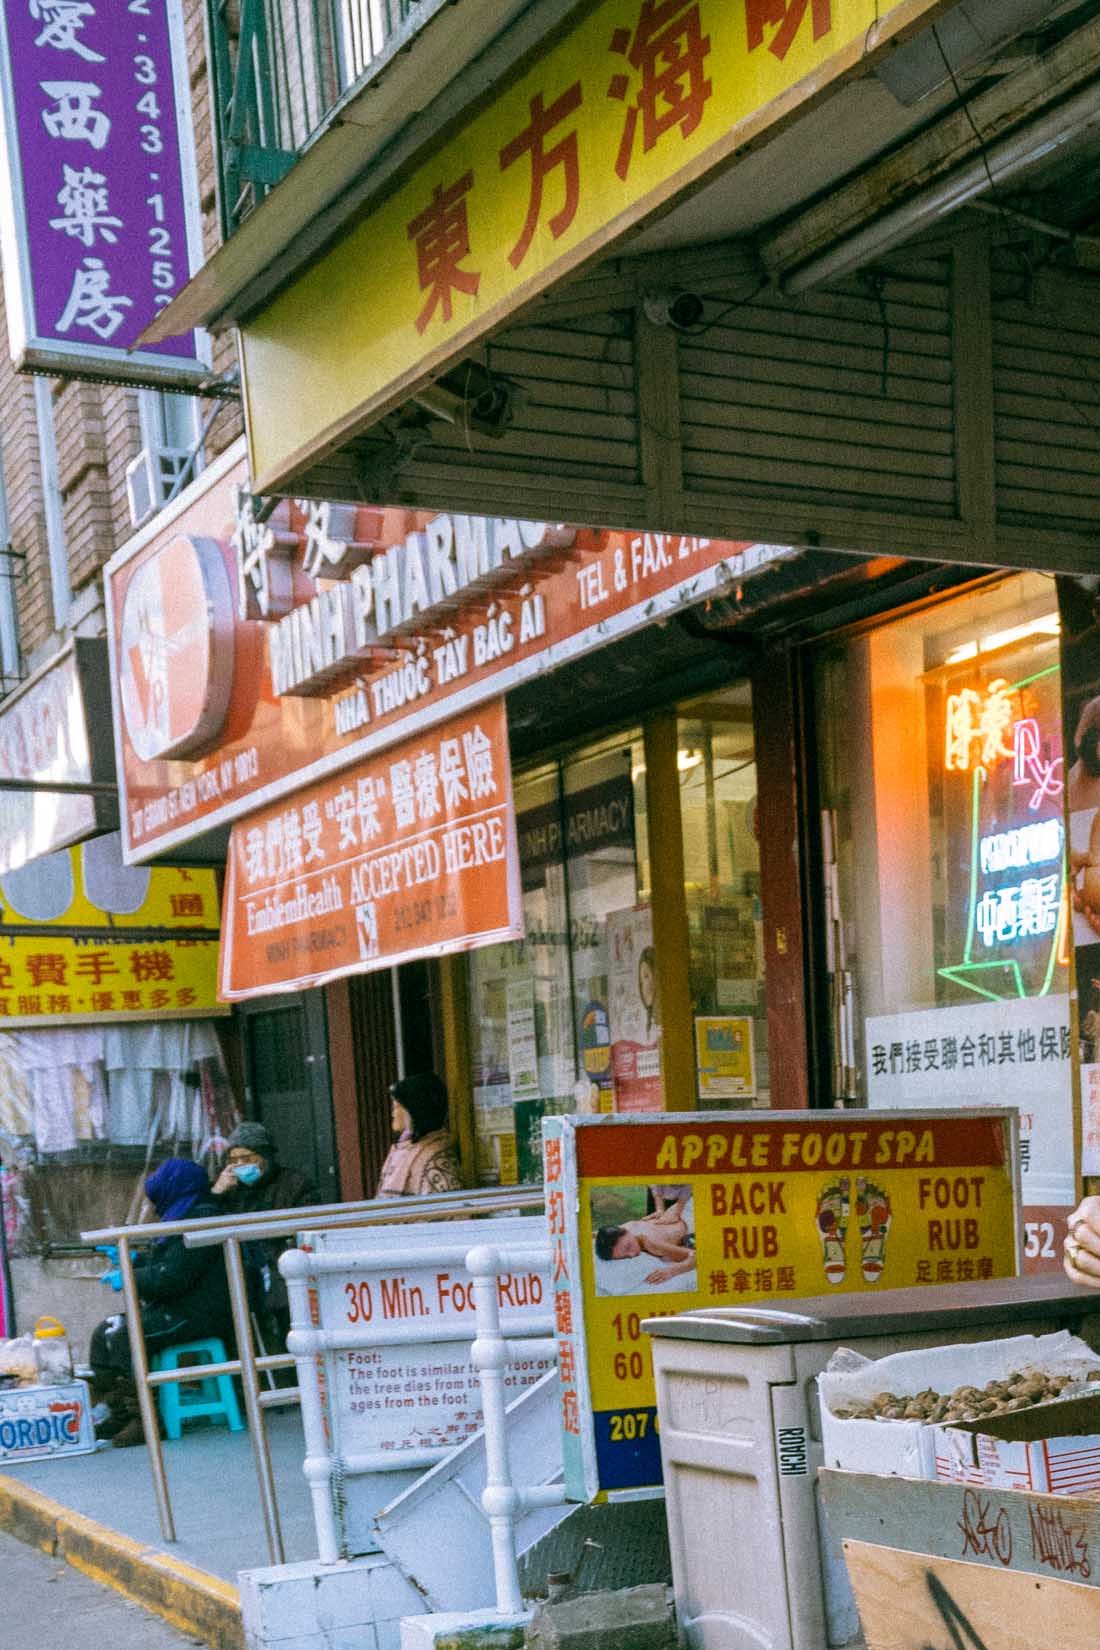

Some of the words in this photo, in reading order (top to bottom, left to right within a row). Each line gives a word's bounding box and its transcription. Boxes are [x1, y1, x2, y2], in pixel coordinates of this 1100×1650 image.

[576, 559, 609, 610] TEL
[613, 547, 628, 592] &
[473, 602, 515, 667] BÁC
[519, 583, 546, 645] ÁI
[549, 796, 630, 853] PARMACY
[349, 839, 441, 905] ACCEPTED
[442, 816, 507, 874] HERE
[655, 1133, 779, 1170] APPLE
[780, 1131, 869, 1167] FOOT
[874, 1130, 936, 1164] SPA
[710, 1181, 787, 1217] BACK
[917, 1176, 985, 1211] FOOT
[722, 1224, 778, 1260] RUB
[928, 1217, 980, 1251] RUB
[709, 1264, 796, 1297] 推拿指壓
[344, 1280, 373, 1324] 30
[380, 1276, 430, 1319] Min.
[436, 1273, 477, 1314] Foo
[496, 1273, 543, 1308] Rub
[611, 1312, 641, 1342] 10
[347, 1352, 382, 1365] Foot:
[349, 1368, 374, 1380] The
[376, 1366, 403, 1379] foot
[406, 1366, 417, 1377] is
[420, 1364, 465, 1377] similar
[613, 1350, 643, 1381] 60
[350, 1383, 370, 1396] the
[374, 1383, 400, 1395] tree
[404, 1379, 431, 1392] dies
[434, 1378, 465, 1391] from
[468, 1377, 481, 1389] th
[350, 1399, 382, 1413] ages
[384, 1396, 414, 1409] from
[418, 1394, 439, 1408] the
[442, 1393, 468, 1406] foot
[609, 1413, 649, 1442] 207
